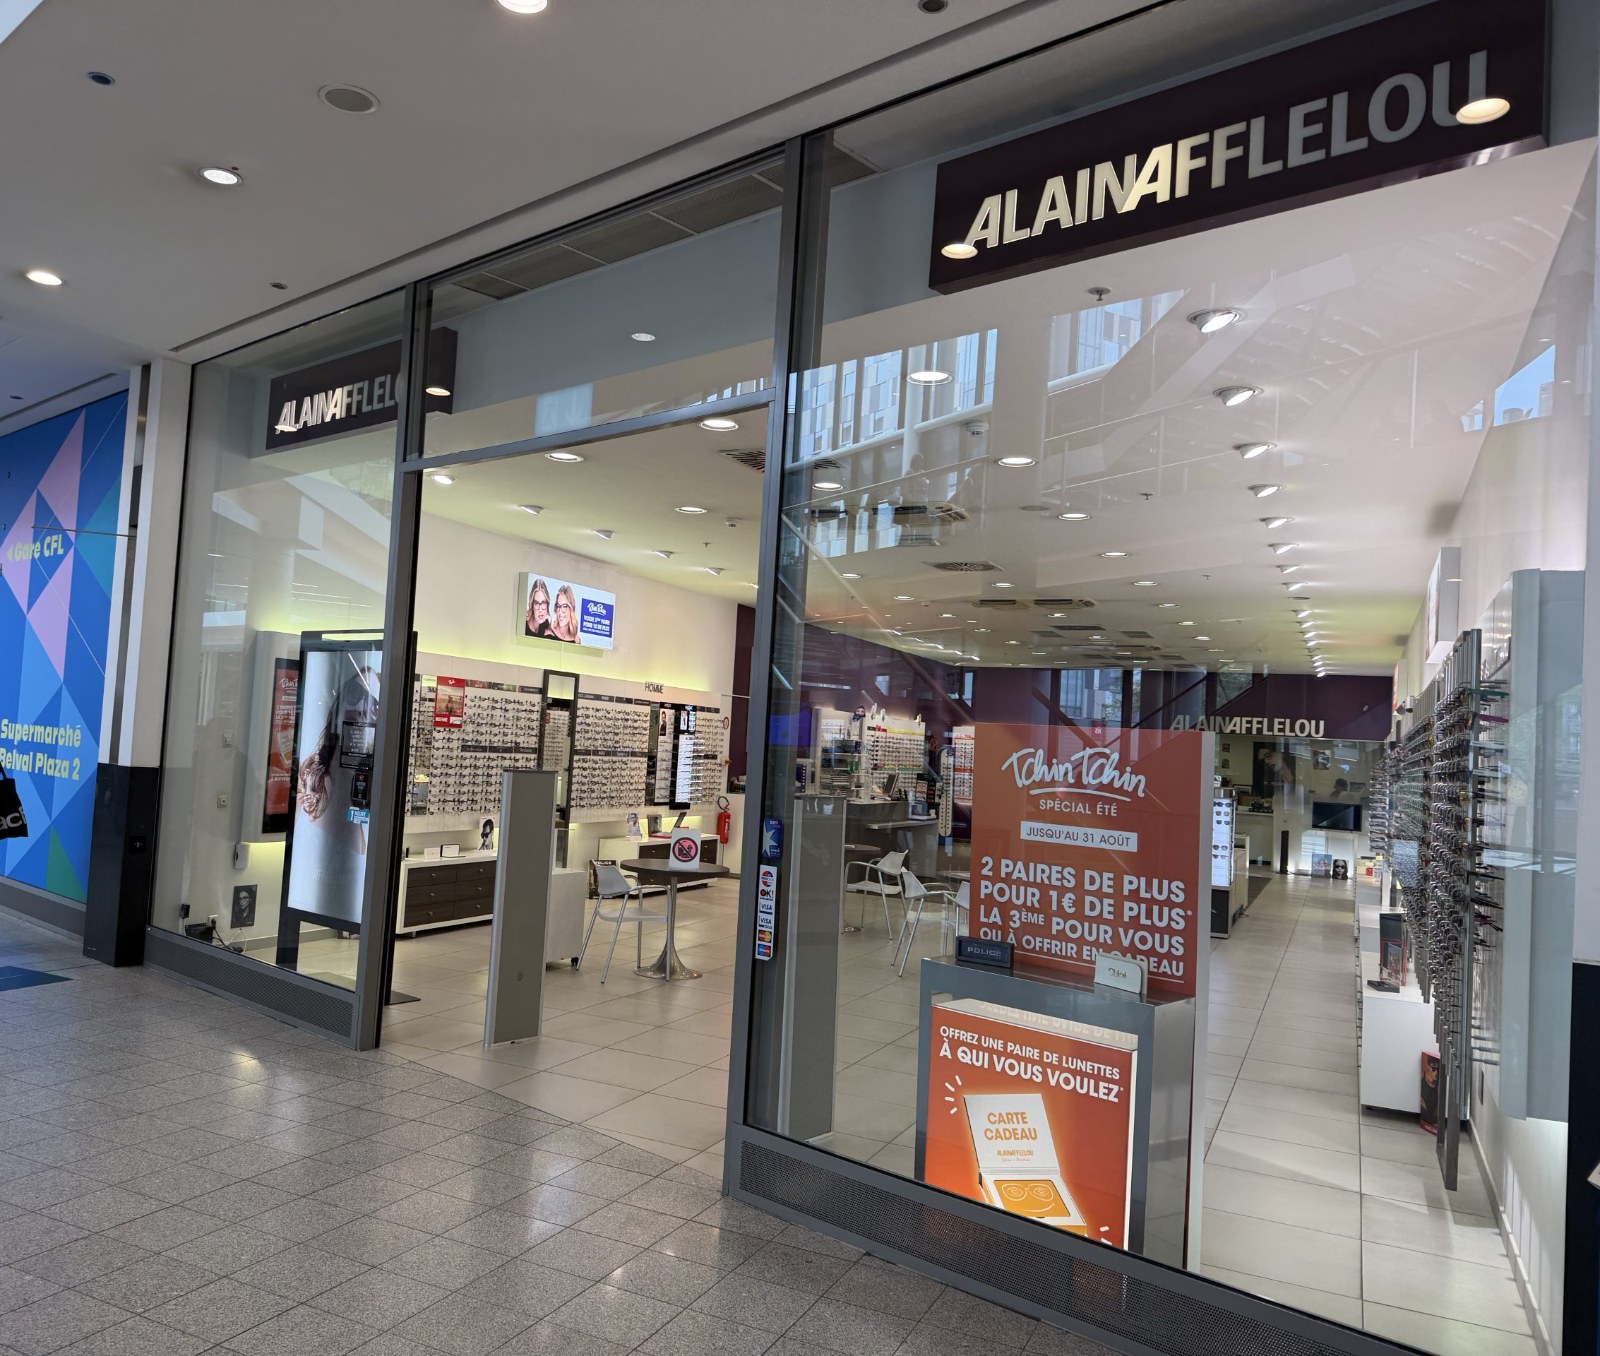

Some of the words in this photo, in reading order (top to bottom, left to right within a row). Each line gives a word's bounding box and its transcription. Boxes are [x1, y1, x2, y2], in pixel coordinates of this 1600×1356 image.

[15, 541, 41, 561] Gare
[43, 534, 64, 557] CFL
[1, 719, 81, 748] Supermarché
[0, 747, 33, 773] Belval
[35, 752, 70, 779] Plaza
[72, 757, 80, 781] 2
[1039, 799, 1091, 815] SPÉCIAL
[1096, 802, 1118, 817] ÉTÉ
[1026, 826, 1079, 843] JUSQU'AU
[1082, 831, 1095, 843] 31
[1099, 831, 1131, 848] AOÛT
[981, 856, 993, 877] 2
[1000, 858, 1076, 888] PAIRES
[1084, 870, 1114, 894] DE
[1123, 874, 1185, 903] PLUS
[980, 880, 1040, 908] POUR
[1049, 890, 1076, 914] 1€
[1084, 896, 1114, 920] DE
[761, 917, 772, 925] VISA
[980, 905, 1002, 926] LA
[1051, 917, 1113, 946] POUR
[1118, 927, 1185, 956] VOUS
[967, 945, 1002, 957] POLICE
[980, 927, 1002, 942] OU
[1007, 929, 1017, 946] À
[1022, 935, 1077, 958] OFFRIR
[939, 1038, 951, 1058] À
[957, 1046, 989, 1070] QUI
[993, 1054, 1043, 1084] VOUS
[940, 1025, 979, 1046] OFFREZ
[982, 1036, 1004, 1051] UNE
[1007, 1042, 1040, 1060] PAIRE
[1043, 1051, 1059, 1066] DE
[1062, 1055, 1120, 1080] LUNETTES
[987, 1112, 1028, 1125] CARTE
[984, 1127, 1038, 1141] CADEAU
